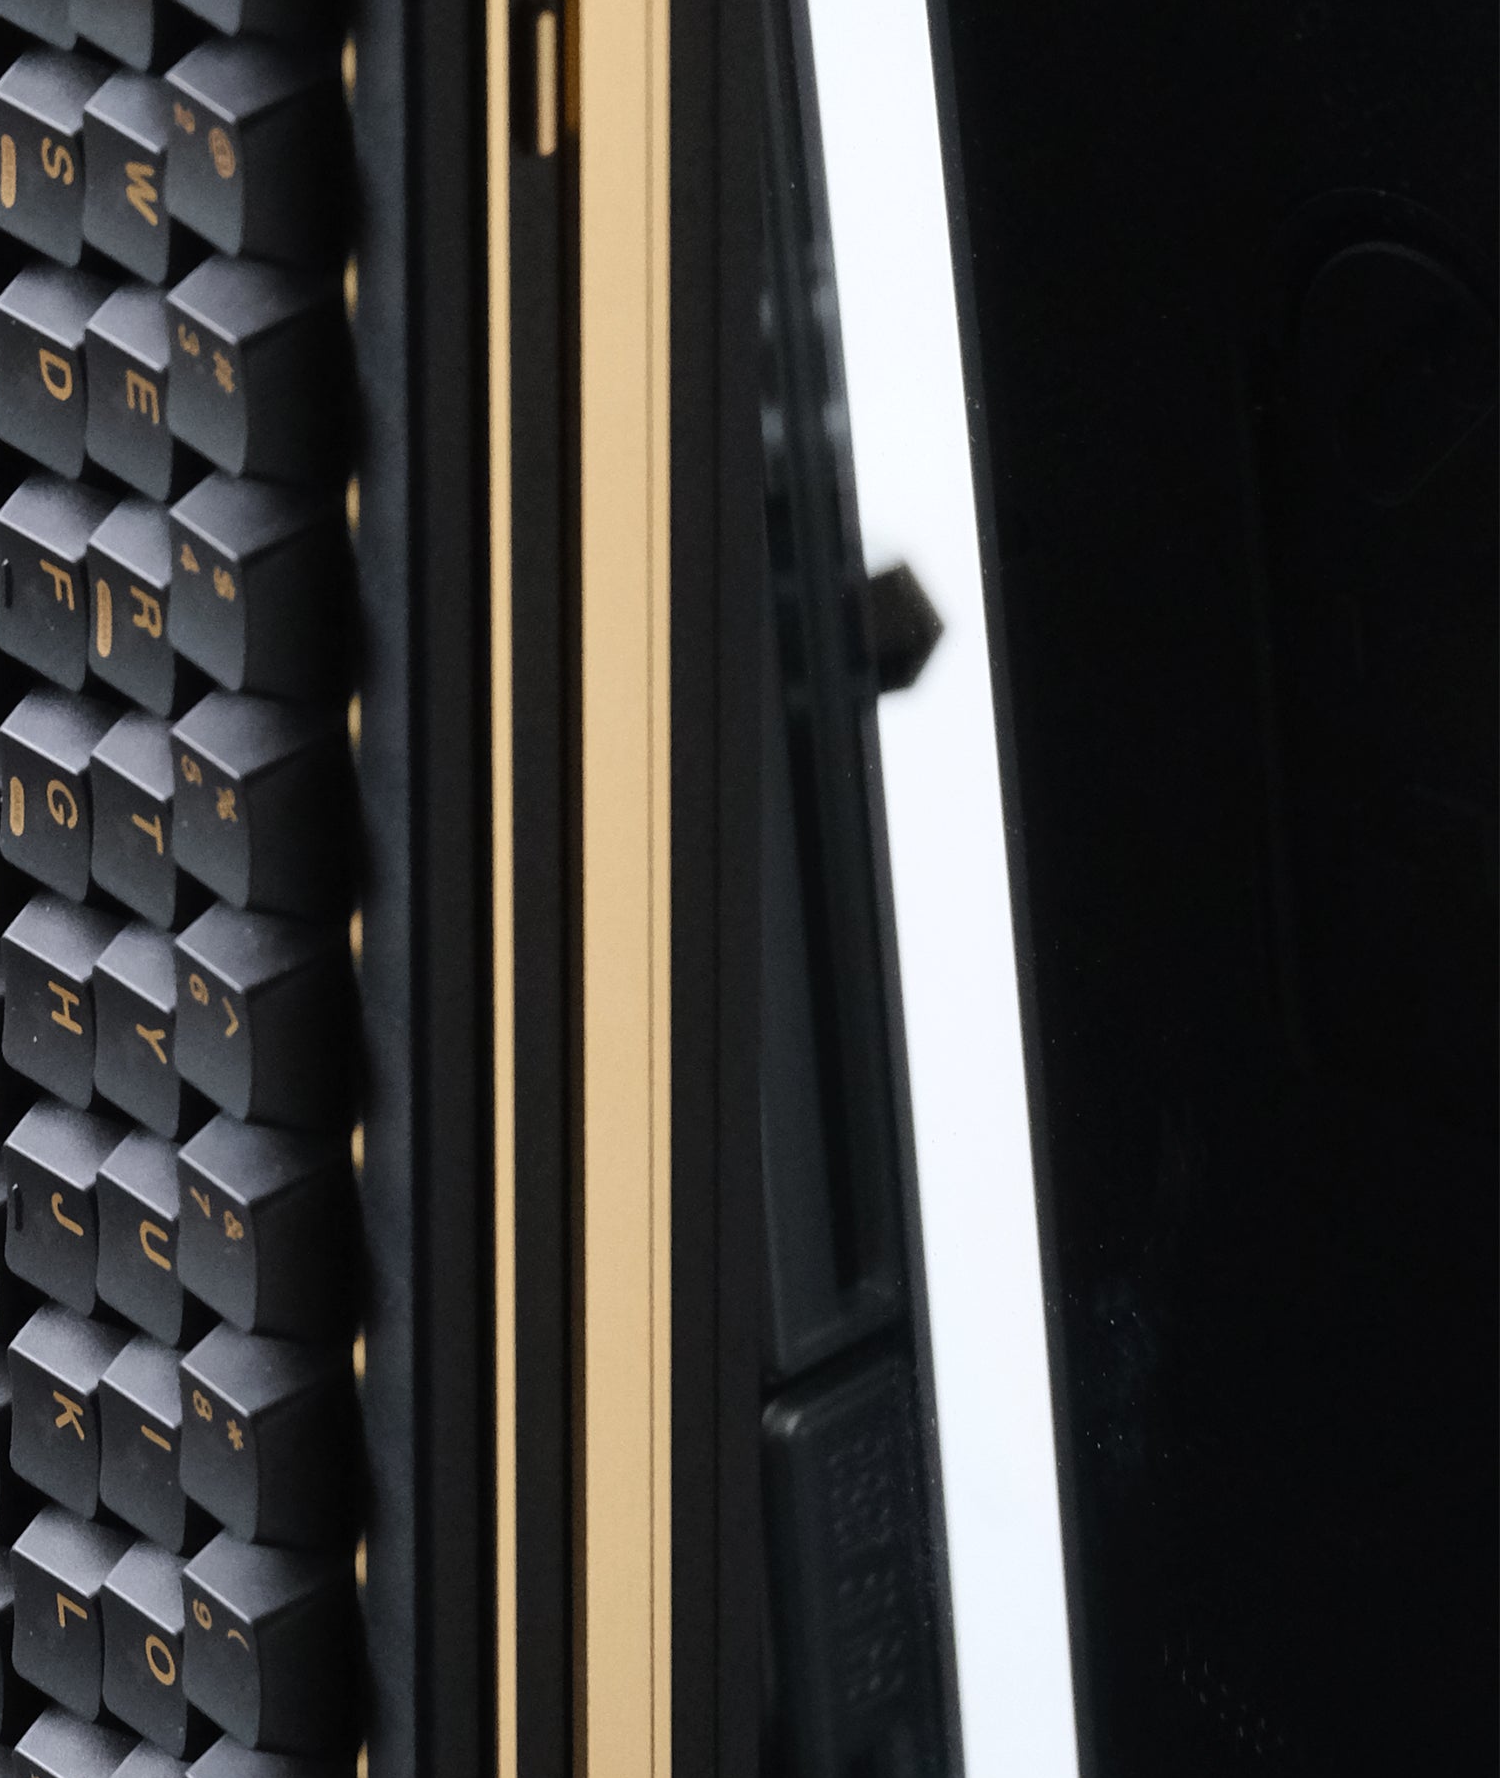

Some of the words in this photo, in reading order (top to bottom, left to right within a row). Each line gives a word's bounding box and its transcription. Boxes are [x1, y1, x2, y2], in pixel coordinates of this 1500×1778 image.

[42, 138, 73, 184] S
[126, 163, 157, 225] W
[178, 325, 199, 356] 3
[40, 349, 72, 401] D
[126, 370, 159, 424] E
[180, 544, 199, 572] 4
[40, 560, 74, 610] F
[131, 587, 162, 638] R
[47, 780, 78, 829] G
[132, 814, 163, 854] T
[48, 981, 82, 1034] H
[189, 974, 208, 1005] 6
[136, 1024, 167, 1064] Y
[52, 1193, 83, 1236] J
[190, 1187, 211, 1218] 7
[140, 1221, 171, 1270] U
[224, 1211, 243, 1240] &
[53, 1391, 84, 1440] K
[193, 1390, 212, 1421] 8
[141, 1426, 171, 1451] I
[57, 1594, 87, 1627] L
[193, 1600, 212, 1630] 9
[146, 1635, 175, 1685] O
